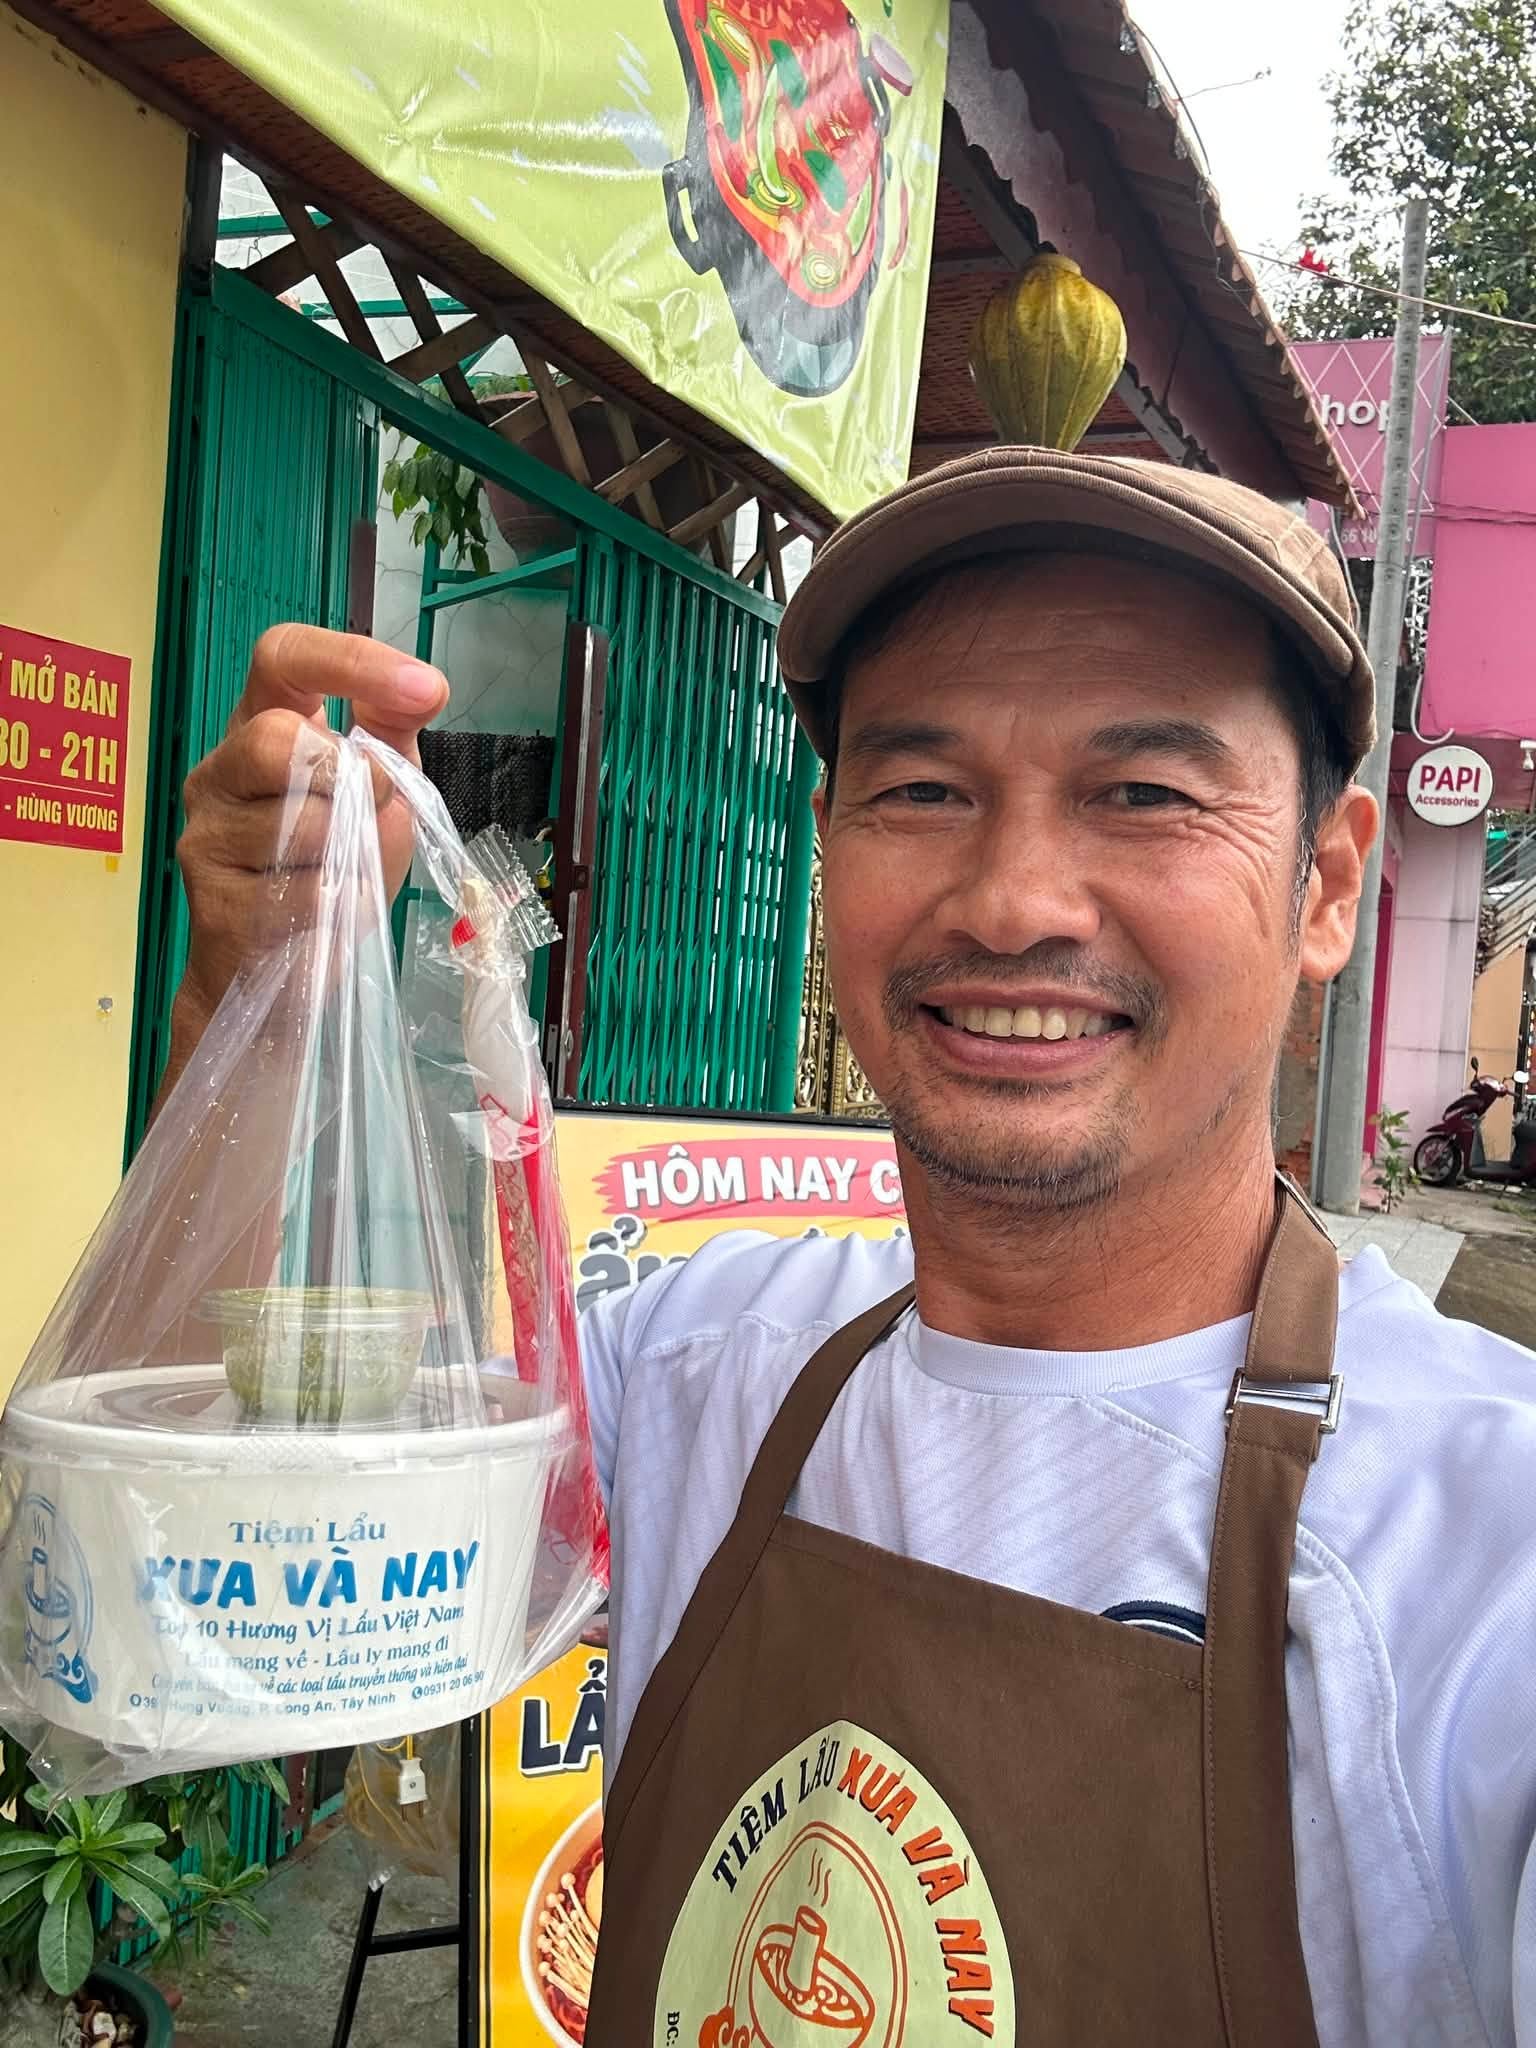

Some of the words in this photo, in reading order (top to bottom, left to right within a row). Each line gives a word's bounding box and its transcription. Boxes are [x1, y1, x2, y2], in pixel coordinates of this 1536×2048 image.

[10, 655, 57, 704] MỞ
[64, 669, 118, 718] BÁN
[61, 731, 118, 785] 21H
[1419, 765, 1481, 793] PAPI
[16, 792, 62, 825] HÙNG
[66, 802, 118, 833] VƯƠNG
[1415, 794, 1480, 807] Accessories
[621, 1144, 747, 1209] HÔM
[761, 1156, 857, 1202] NAY
[228, 1520, 315, 1548] Tiệm
[327, 1511, 386, 1542] Lẩu
[284, 1546, 357, 1608] VÀ
[382, 1541, 480, 1601] NAY
[196, 1619, 219, 1638] 10
[226, 1619, 298, 1645] Hương
[306, 1616, 332, 1643] Vị
[383, 1608, 420, 1634] Việt
[424, 1605, 465, 1629] Nam
[366, 1647, 382, 1665] ly
[387, 1640, 432, 1659] mang
[435, 1635, 449, 1651] đi
[277, 1679, 298, 1695] các
[342, 1698, 365, 1712] Tây
[368, 1693, 396, 1706] Ninh
[423, 1682, 446, 1697] 0931
[449, 1679, 461, 1691] 20
[712, 1777, 788, 1894] TIỆM
[837, 1746, 918, 1836] XƯA
[902, 1826, 970, 1905] VÀ
[936, 1918, 996, 2039] NAY
[666, 2011, 680, 2047] ĐC:
